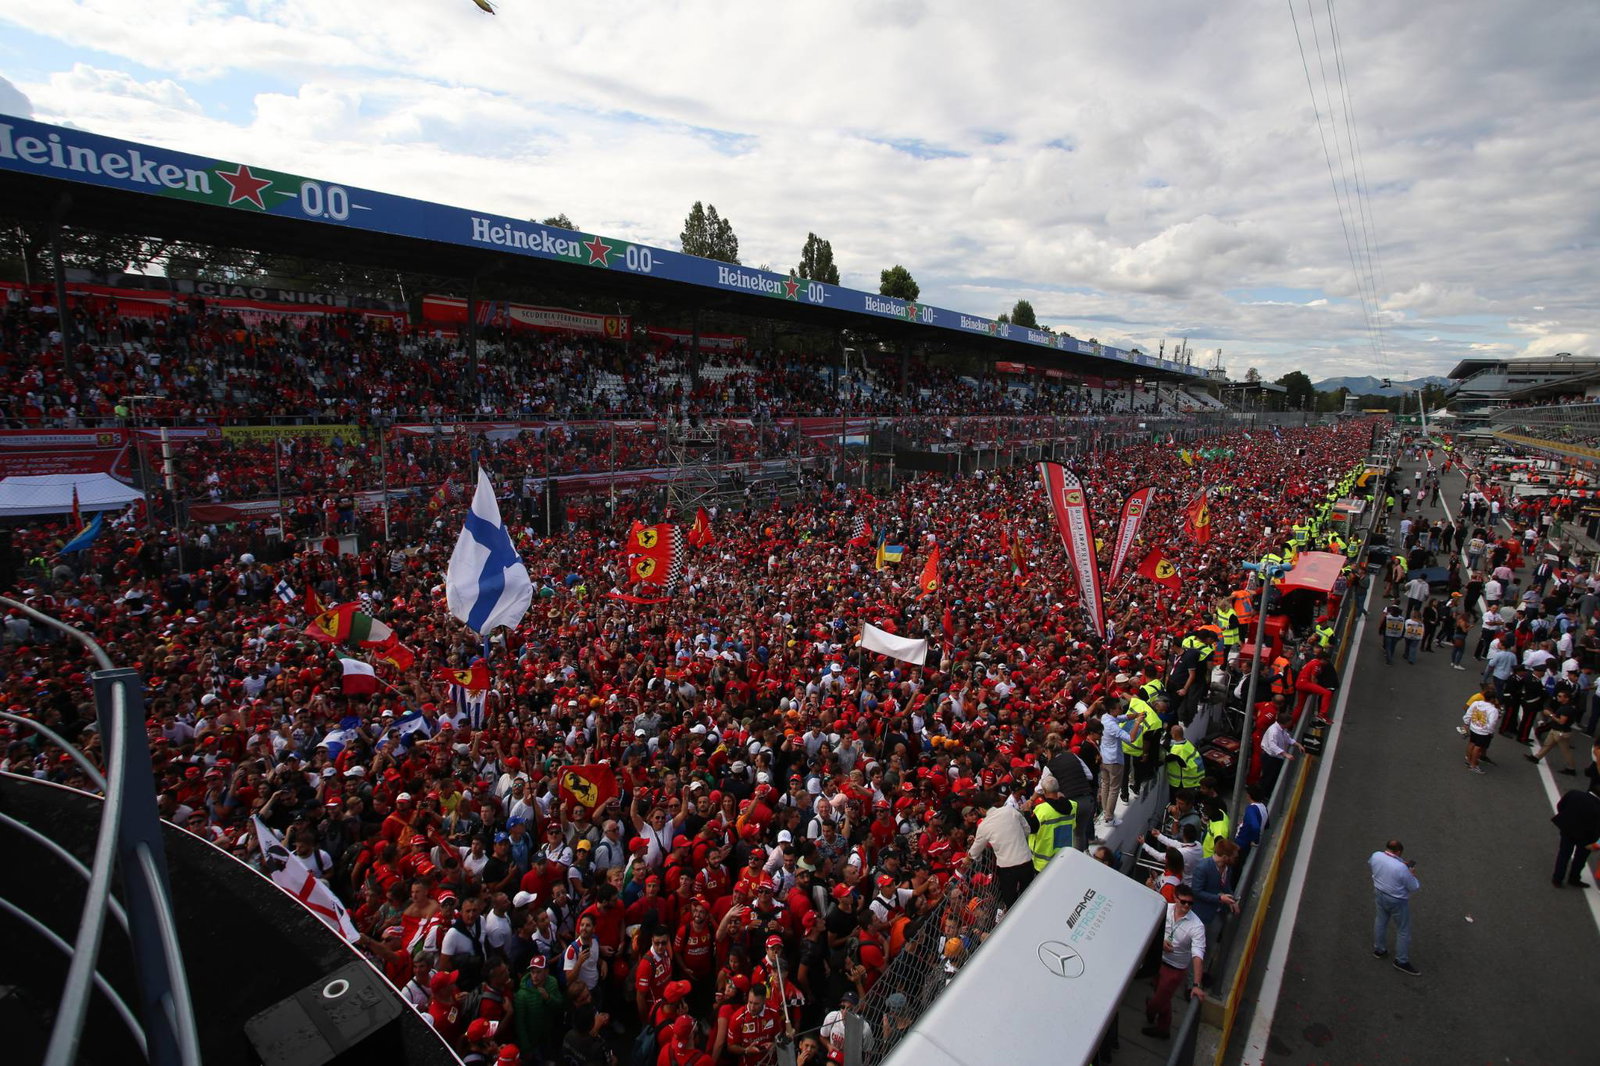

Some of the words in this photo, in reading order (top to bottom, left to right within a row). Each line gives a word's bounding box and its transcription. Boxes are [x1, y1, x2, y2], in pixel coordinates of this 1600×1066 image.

[300, 180, 349, 221] 0.0
[471, 217, 582, 259] Heineken
[626, 244, 652, 274] 0.0
[197, 281, 267, 301] CIAO
[278, 291, 334, 306] NIKI
[718, 266, 782, 294] Heineken
[808, 282, 824, 304] 0.0
[521, 310, 555, 320] SCUDERIA
[865, 296, 906, 317] Heineken
[922, 306, 934, 324] 0.0
[960, 316, 989, 333] Heineken
[1070, 894, 1107, 943] PETRONAS
[1085, 899, 1114, 941] MOTORSPORT
